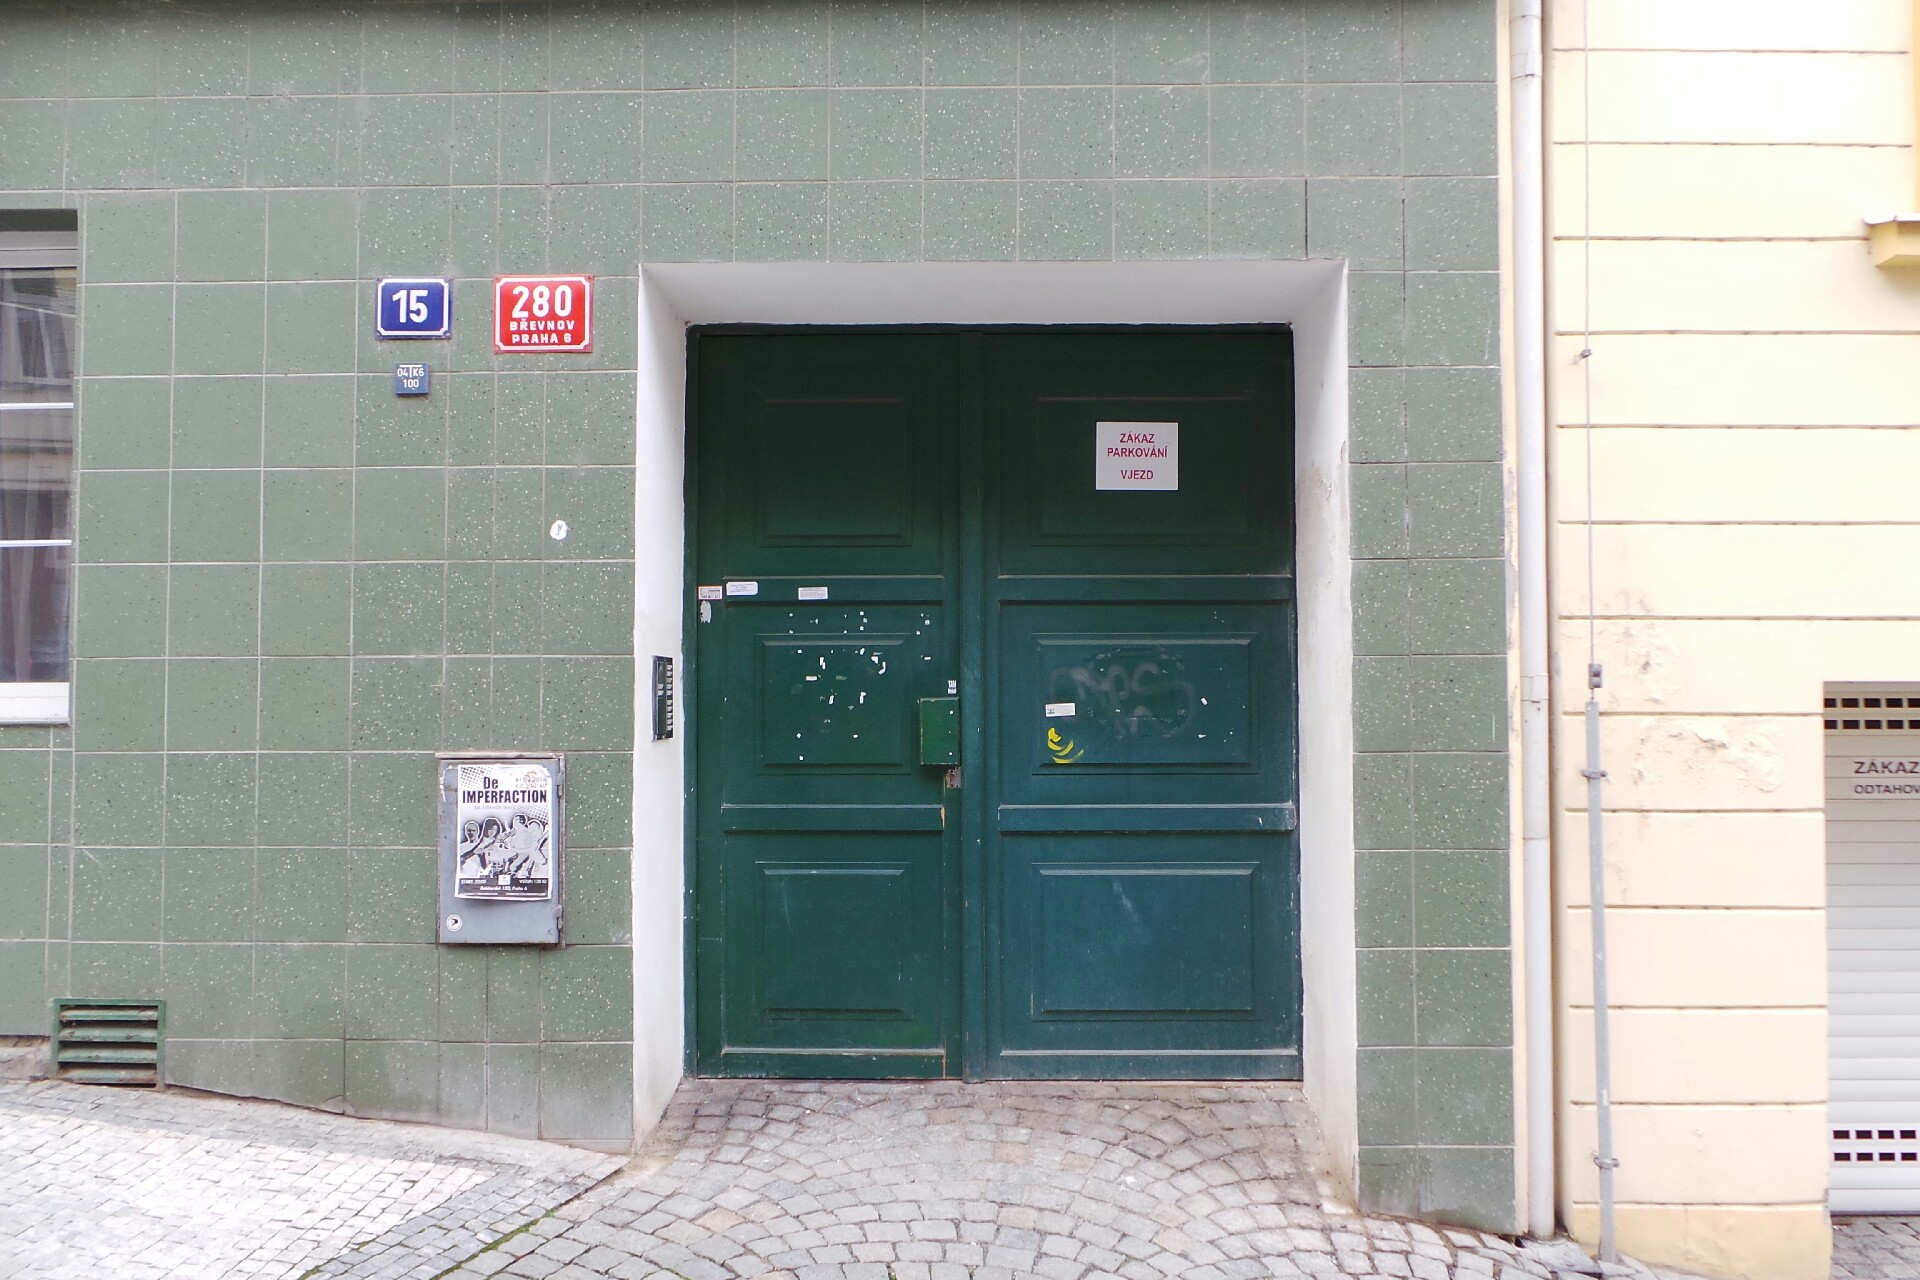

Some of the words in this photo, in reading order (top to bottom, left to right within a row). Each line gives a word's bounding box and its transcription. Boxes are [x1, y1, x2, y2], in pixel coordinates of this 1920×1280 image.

[391, 289, 429, 323] 15
[511, 284, 573, 318] 280
[509, 317, 575, 331] BŘEVNOV
[511, 333, 559, 344] PRAHA
[563, 332, 573, 343] 6
[403, 378, 420, 388] 100
[1119, 431, 1155, 443] ZÁKAZ
[1106, 445, 1168, 458] PARKOVÁNÍ
[1120, 469, 1154, 480] VJEZD
[1854, 758, 1920, 774] ZÁKAZ
[483, 776, 499, 790] De
[462, 789, 548, 804] IMPERFACTION
